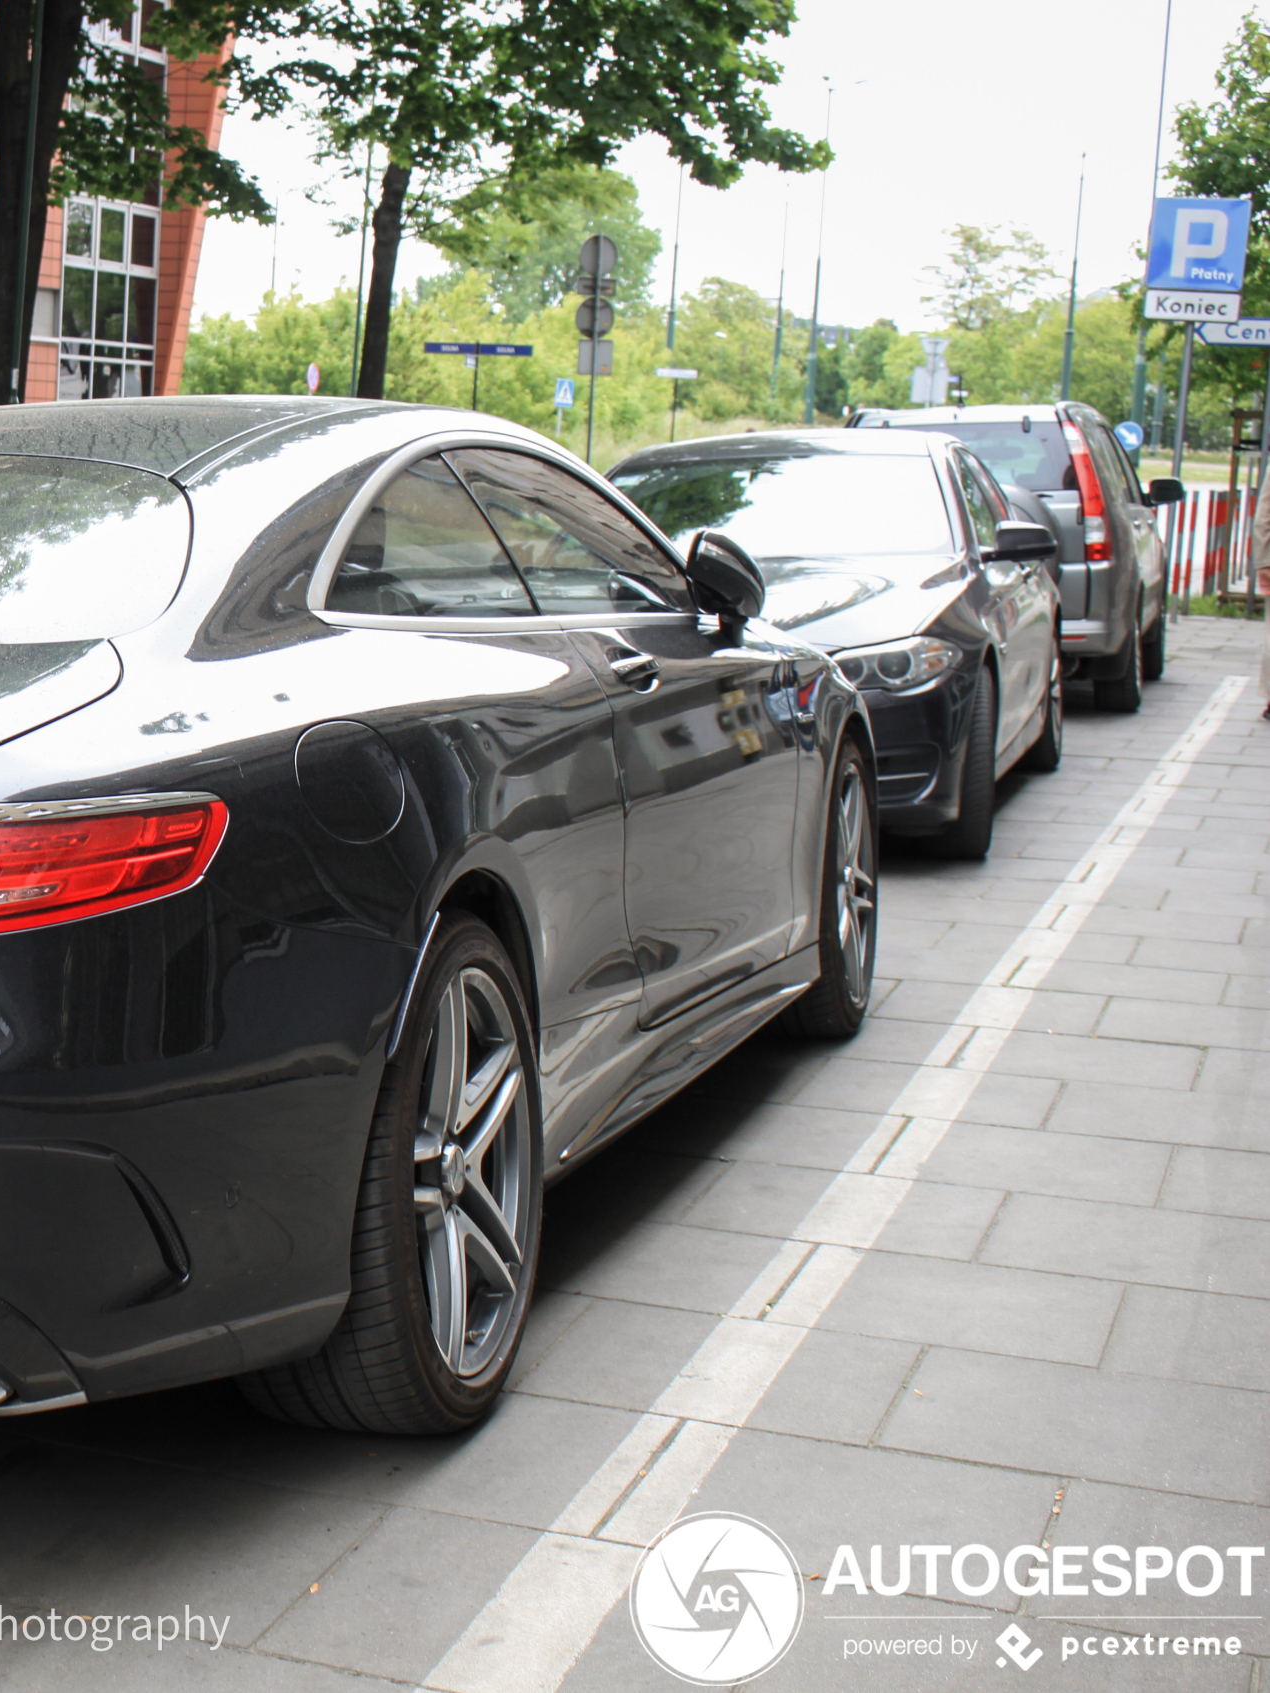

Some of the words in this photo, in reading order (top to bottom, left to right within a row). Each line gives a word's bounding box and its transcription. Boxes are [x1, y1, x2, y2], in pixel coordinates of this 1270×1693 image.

[1170, 208, 1228, 277] P
[1190, 267, 1235, 284] Płatny
[1155, 296, 1228, 317] Koniec
[1224, 322, 1270, 340] Cen
